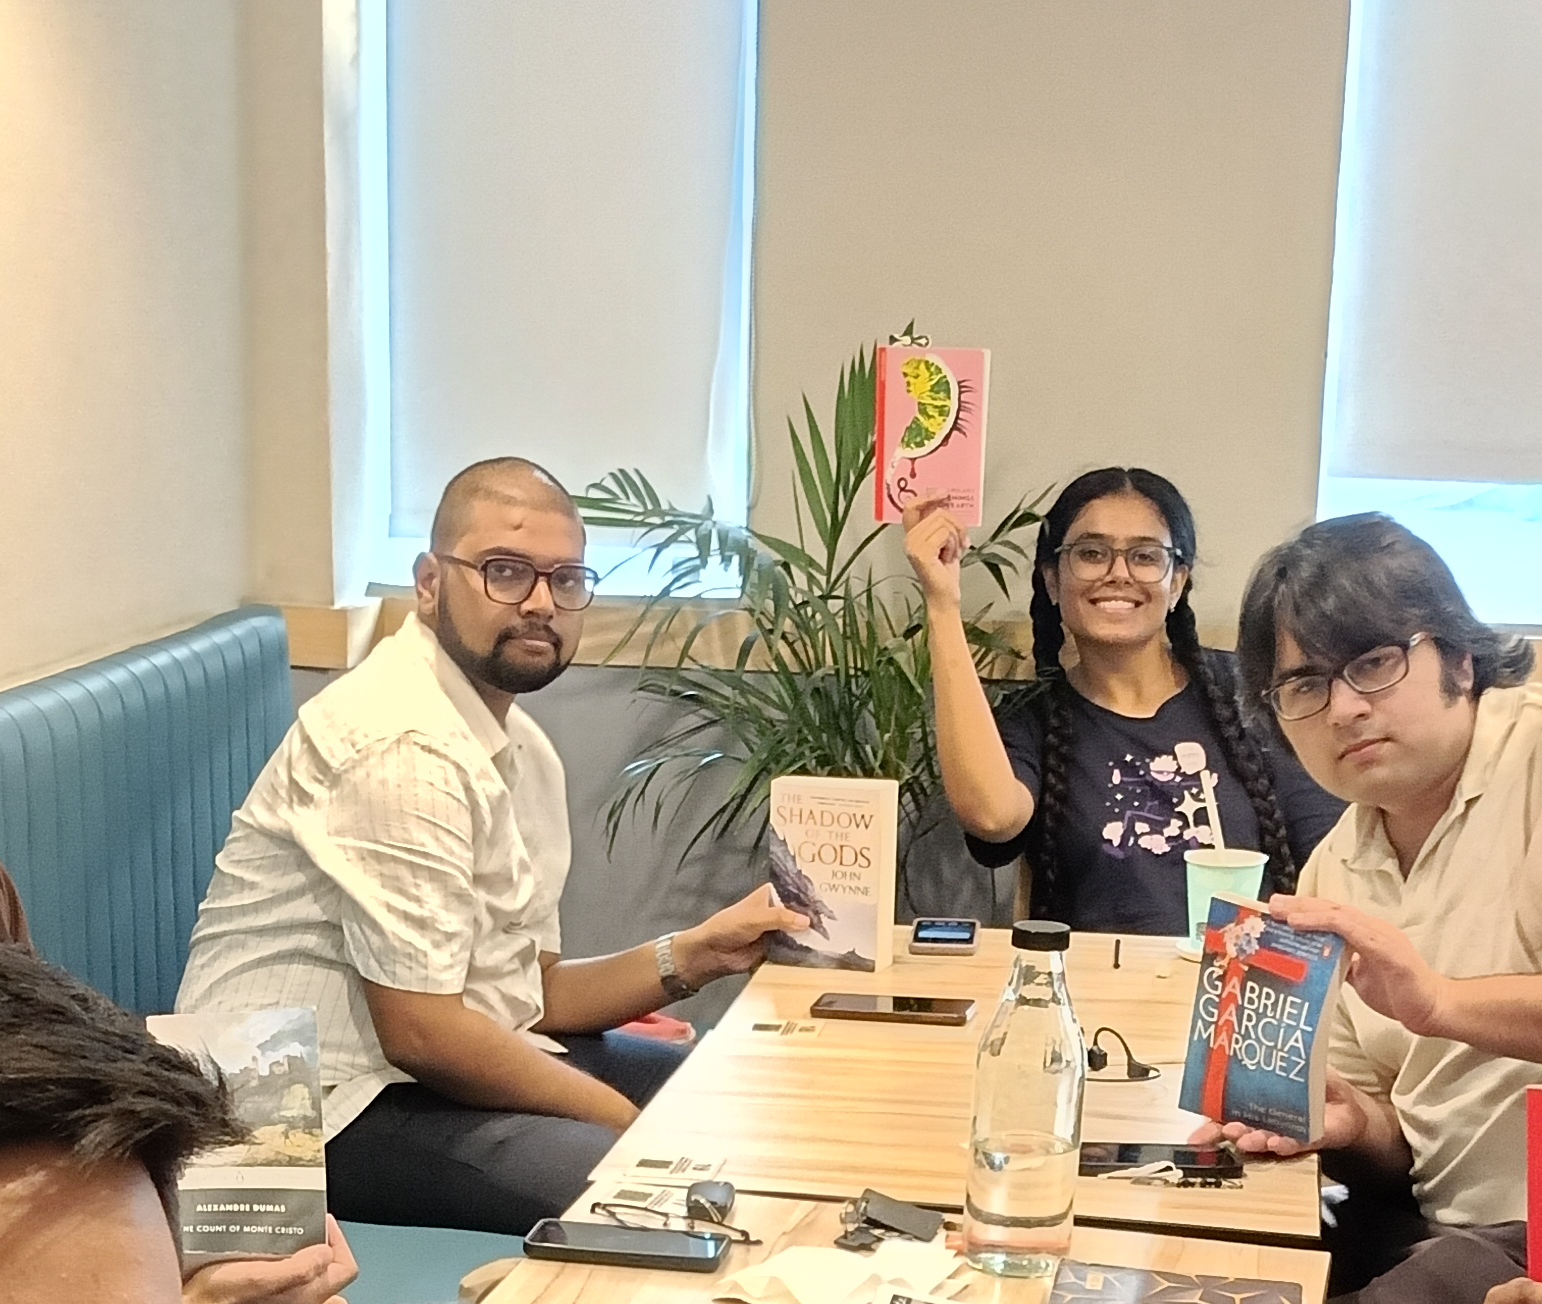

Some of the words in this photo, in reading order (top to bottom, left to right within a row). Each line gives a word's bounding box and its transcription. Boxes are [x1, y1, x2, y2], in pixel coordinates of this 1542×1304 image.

[781, 793, 803, 804] THE
[777, 805, 874, 830] SHADOW
[828, 831, 850, 841] THE
[798, 841, 871, 868] GODS
[831, 870, 862, 881] JOHN
[819, 882, 872, 897] GWYNNE
[1203, 966, 1313, 1032] GABRIEL
[196, 1203, 250, 1213] ALEXANDRE
[252, 1204, 286, 1213] DUMAS
[182, 1225, 194, 1233] HE
[196, 1225, 227, 1233] COUNT
[228, 1225, 240, 1233] OF
[243, 1225, 273, 1234] MONTE
[275, 1226, 304, 1235] CRISTO
